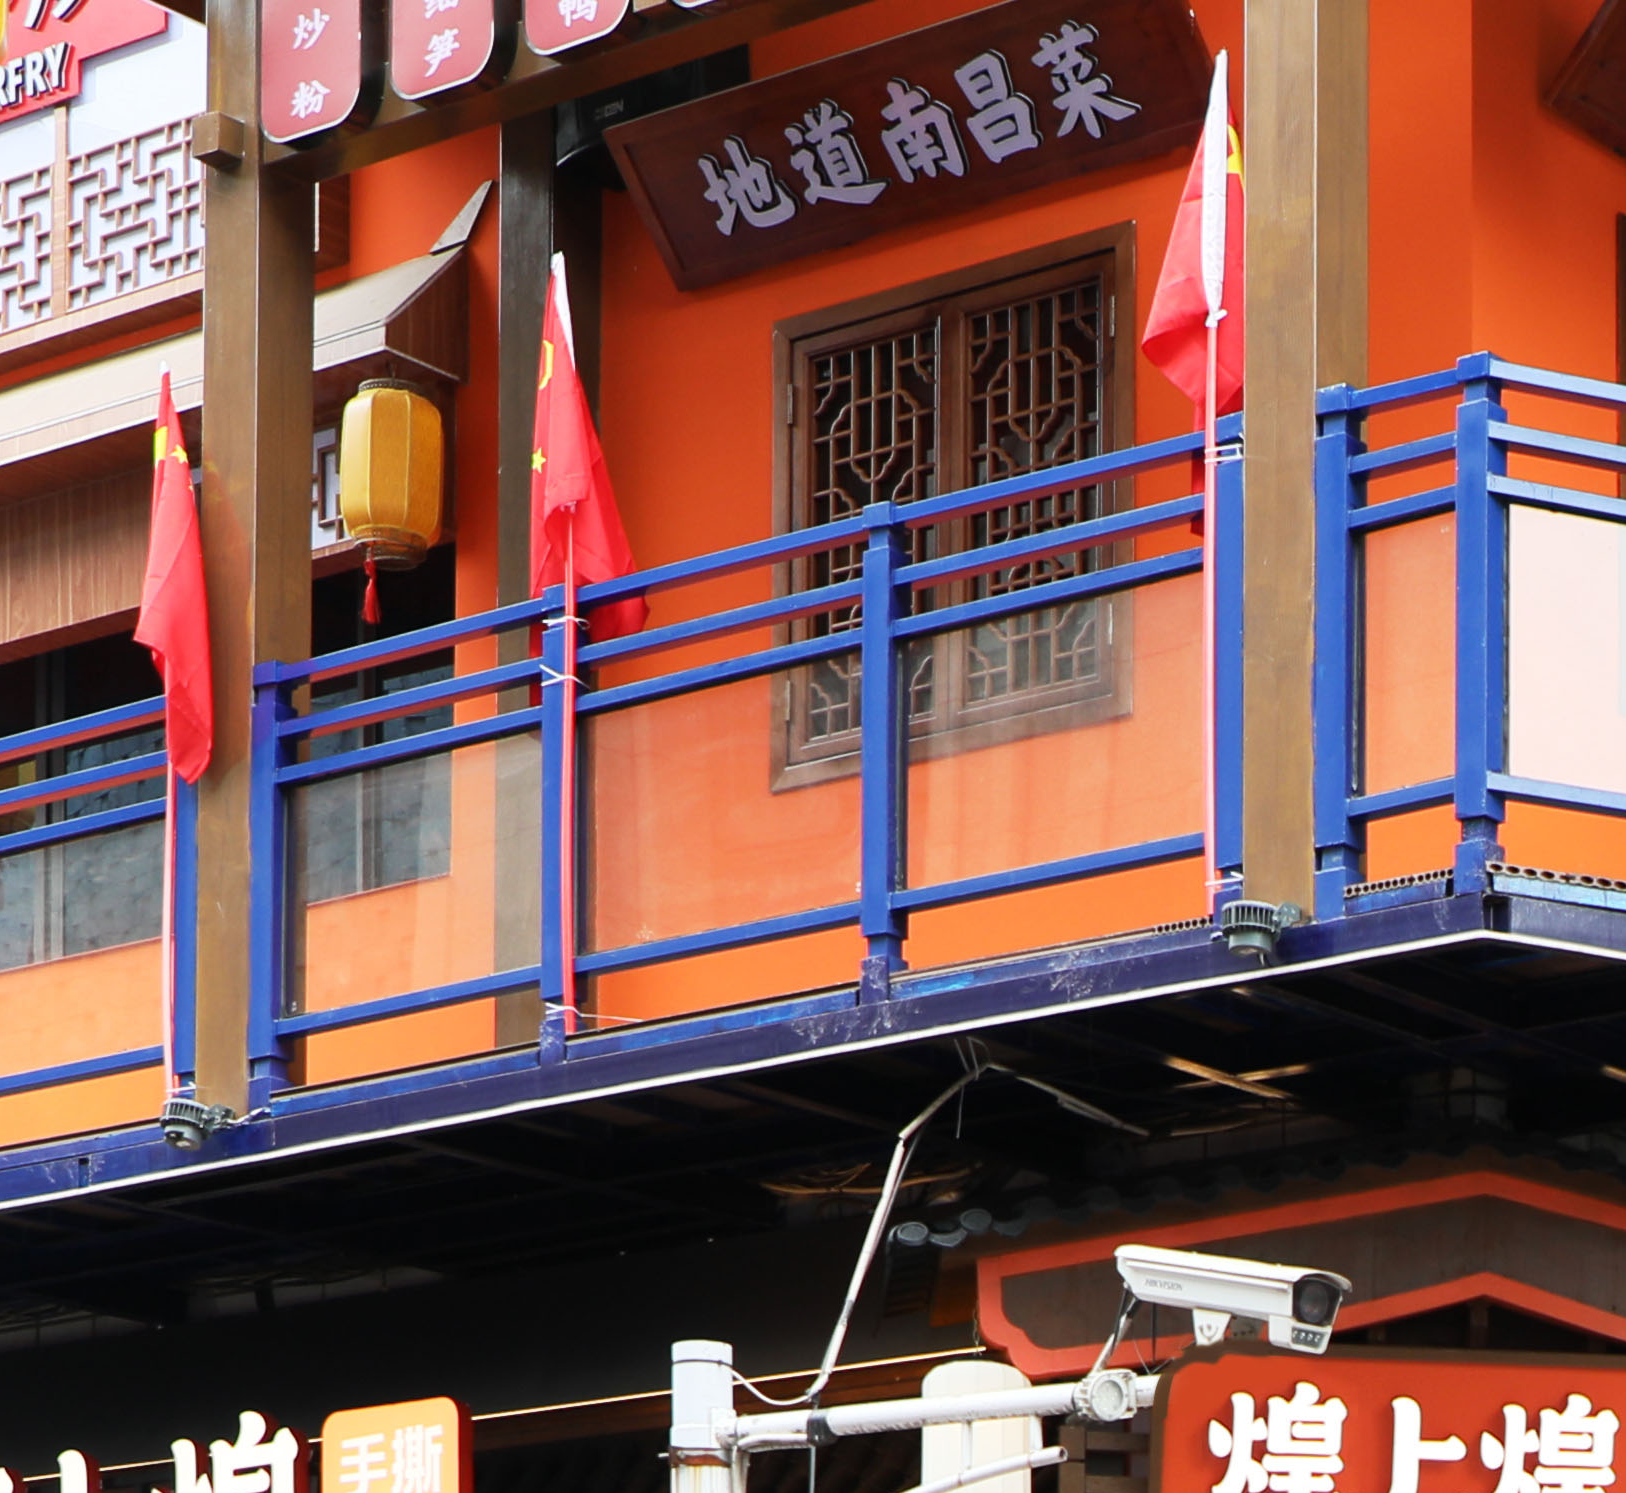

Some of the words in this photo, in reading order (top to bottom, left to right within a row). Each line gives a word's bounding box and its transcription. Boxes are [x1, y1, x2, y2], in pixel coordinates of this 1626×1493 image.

[289, 13, 331, 118] 炒粉
[697, 20, 1142, 236] 地道南昌菜
